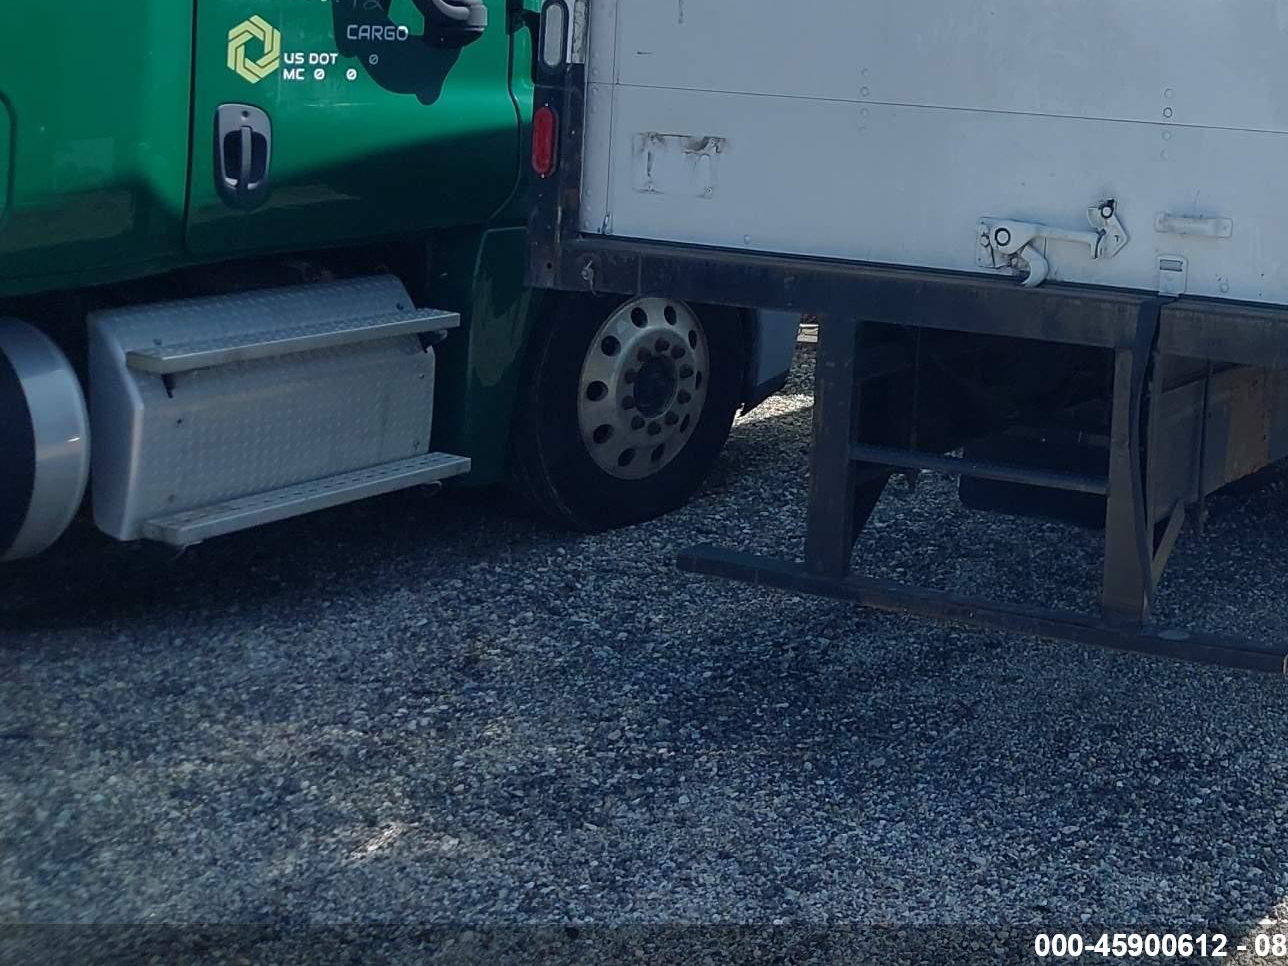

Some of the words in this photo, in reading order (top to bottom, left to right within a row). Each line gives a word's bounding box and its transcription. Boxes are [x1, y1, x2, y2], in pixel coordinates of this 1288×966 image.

[346, 24, 409, 41] CARGO
[283, 53, 305, 64] US
[308, 53, 338, 64] DOT
[283, 69, 305, 80] MC
